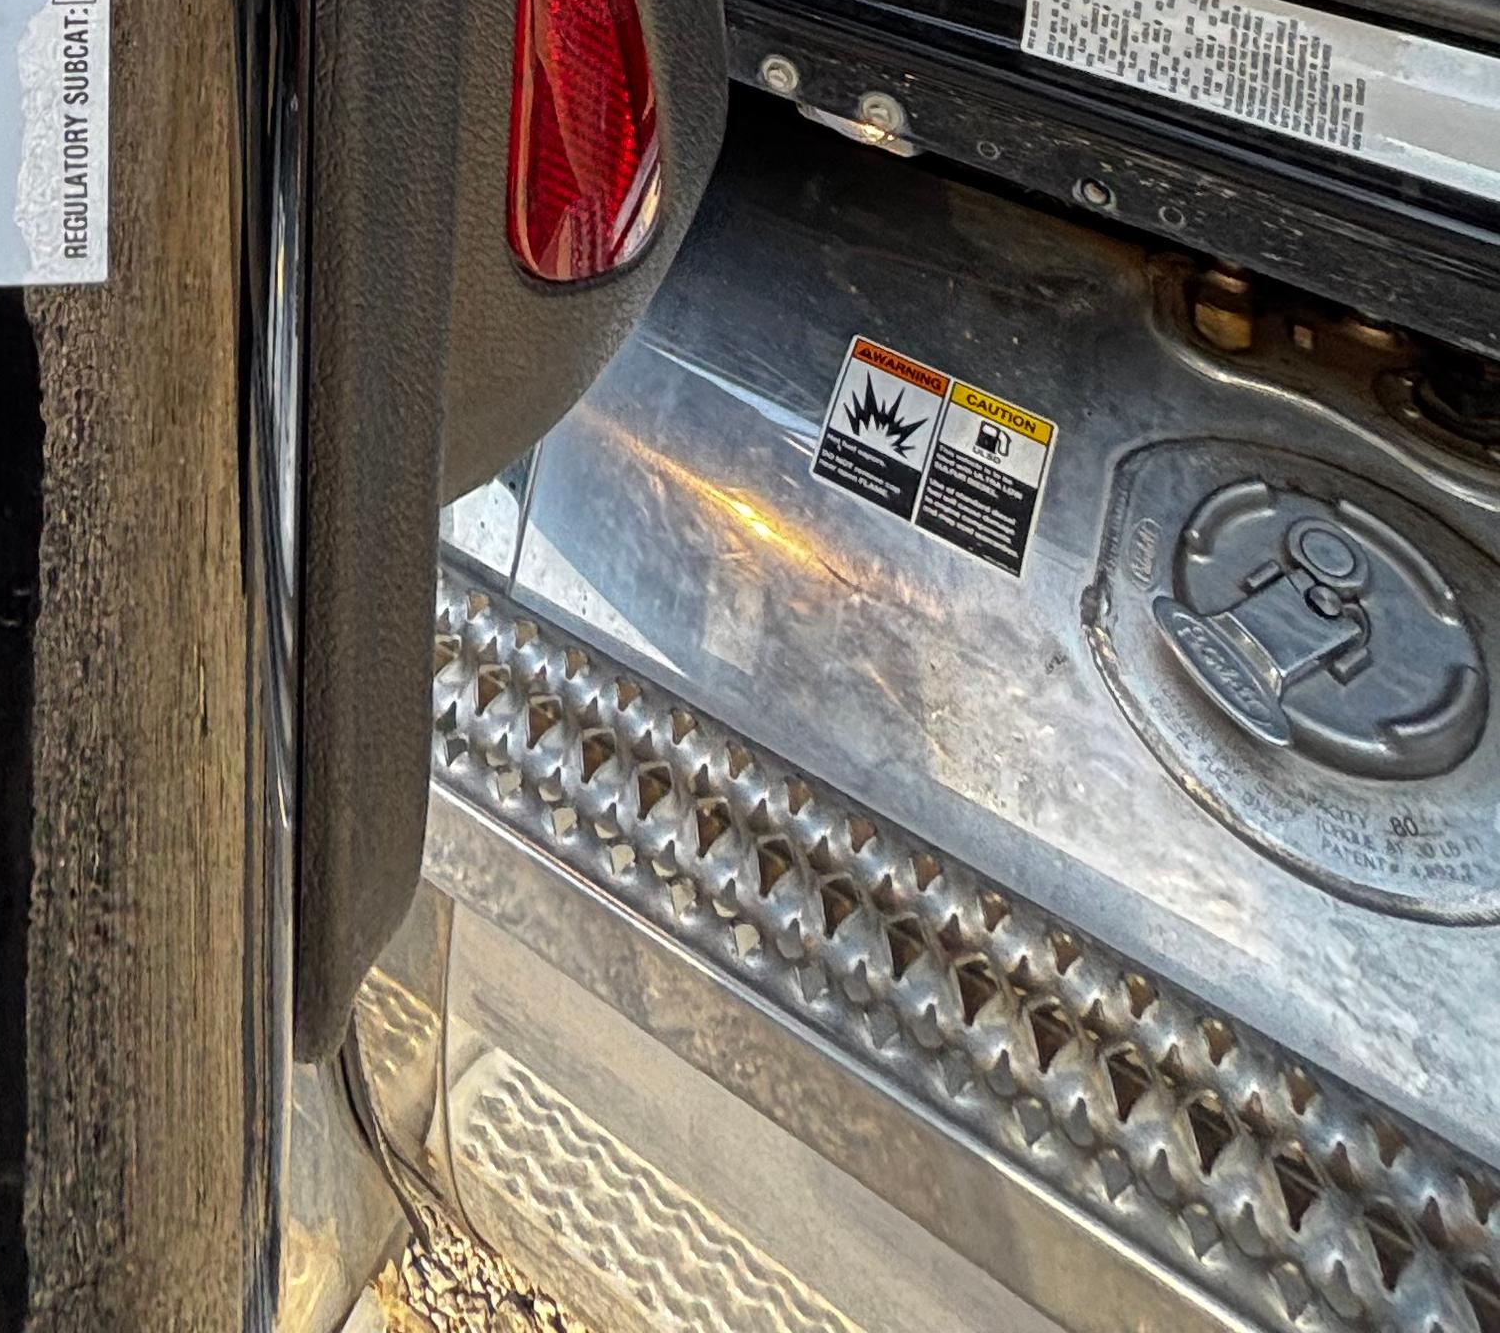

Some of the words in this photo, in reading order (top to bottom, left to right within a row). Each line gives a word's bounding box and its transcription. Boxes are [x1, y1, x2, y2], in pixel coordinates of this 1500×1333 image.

[62, 6, 89, 105] SUBCAT:
[63, 112, 89, 258] REGULATORY
[872, 351, 942, 391] WARNING
[966, 393, 1037, 434] CAUTION
[1389, 816, 1419, 837] 80
